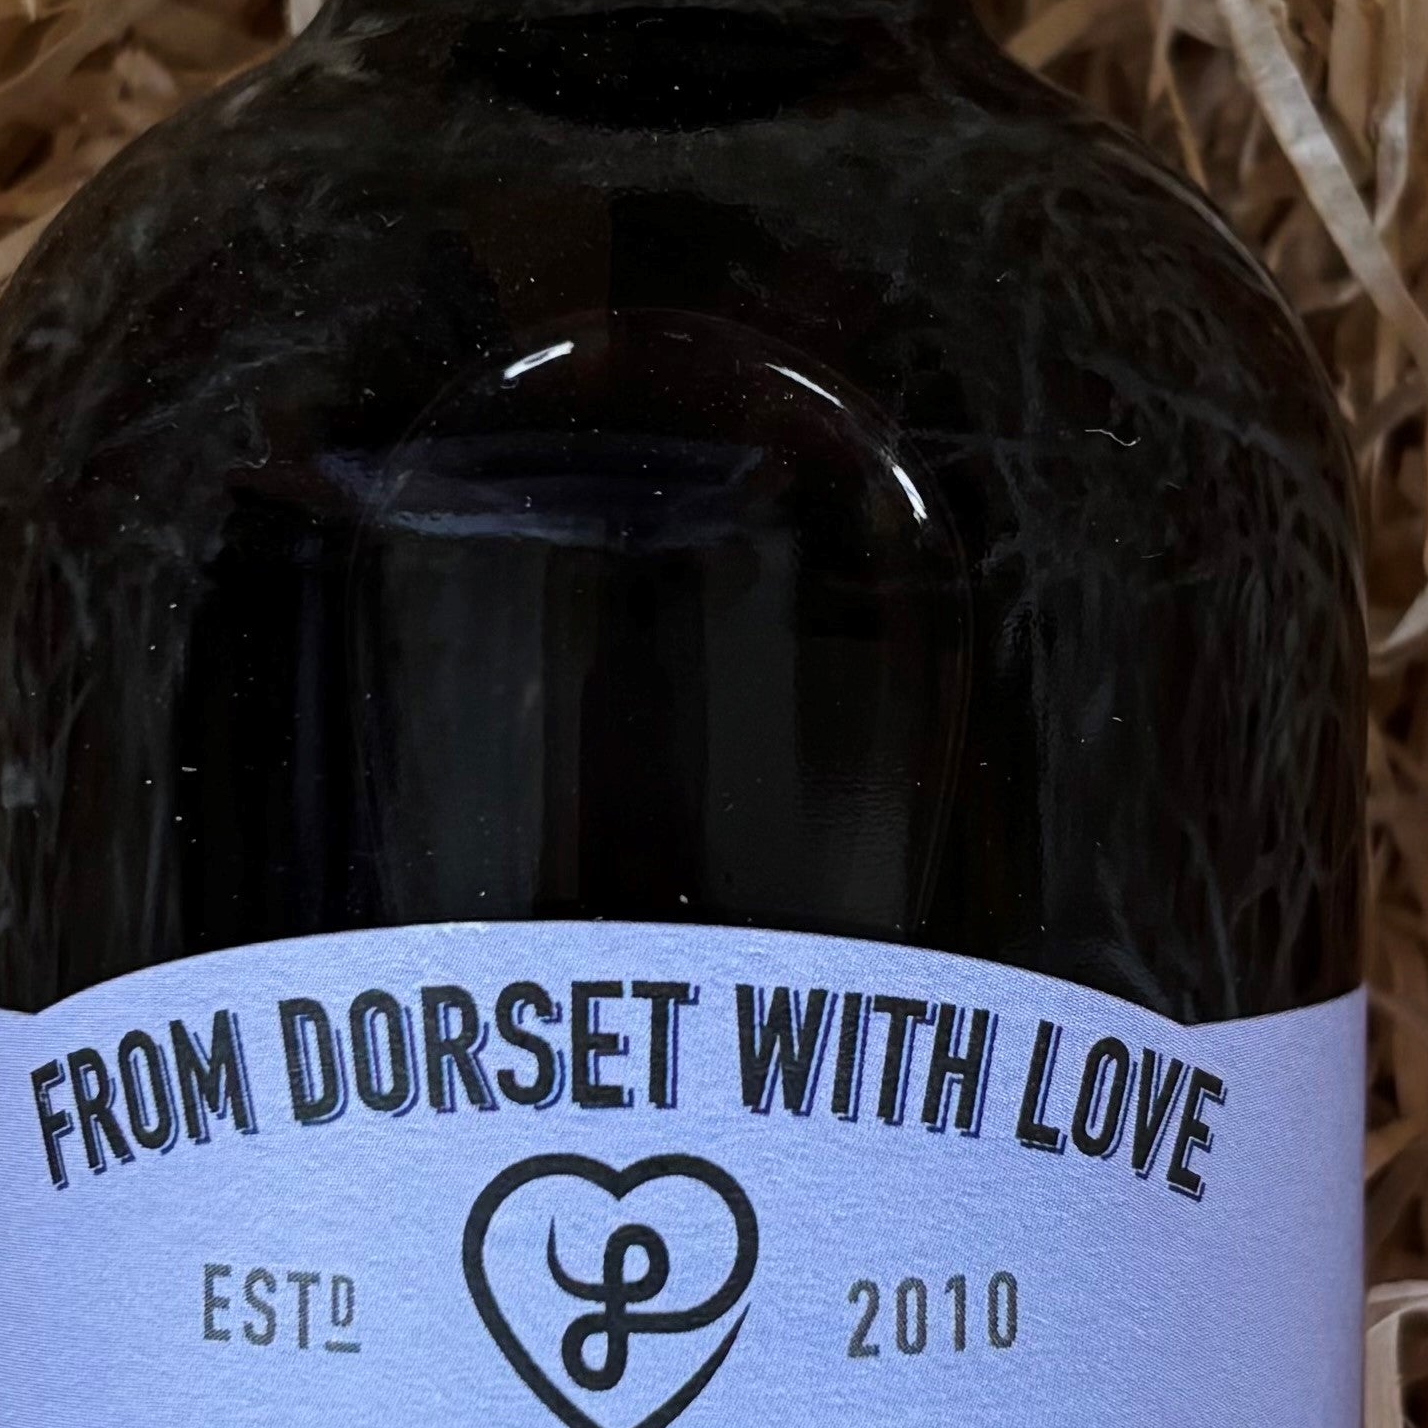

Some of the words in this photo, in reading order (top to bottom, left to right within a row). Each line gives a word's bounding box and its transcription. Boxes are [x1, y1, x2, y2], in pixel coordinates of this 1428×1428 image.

[31, 1010, 259, 1191] FROM
[279, 980, 700, 1127] DORSET
[736, 985, 998, 1139] WITH
[1016, 1021, 1228, 1203] LOVE
[848, 1271, 1017, 1358] 2010
